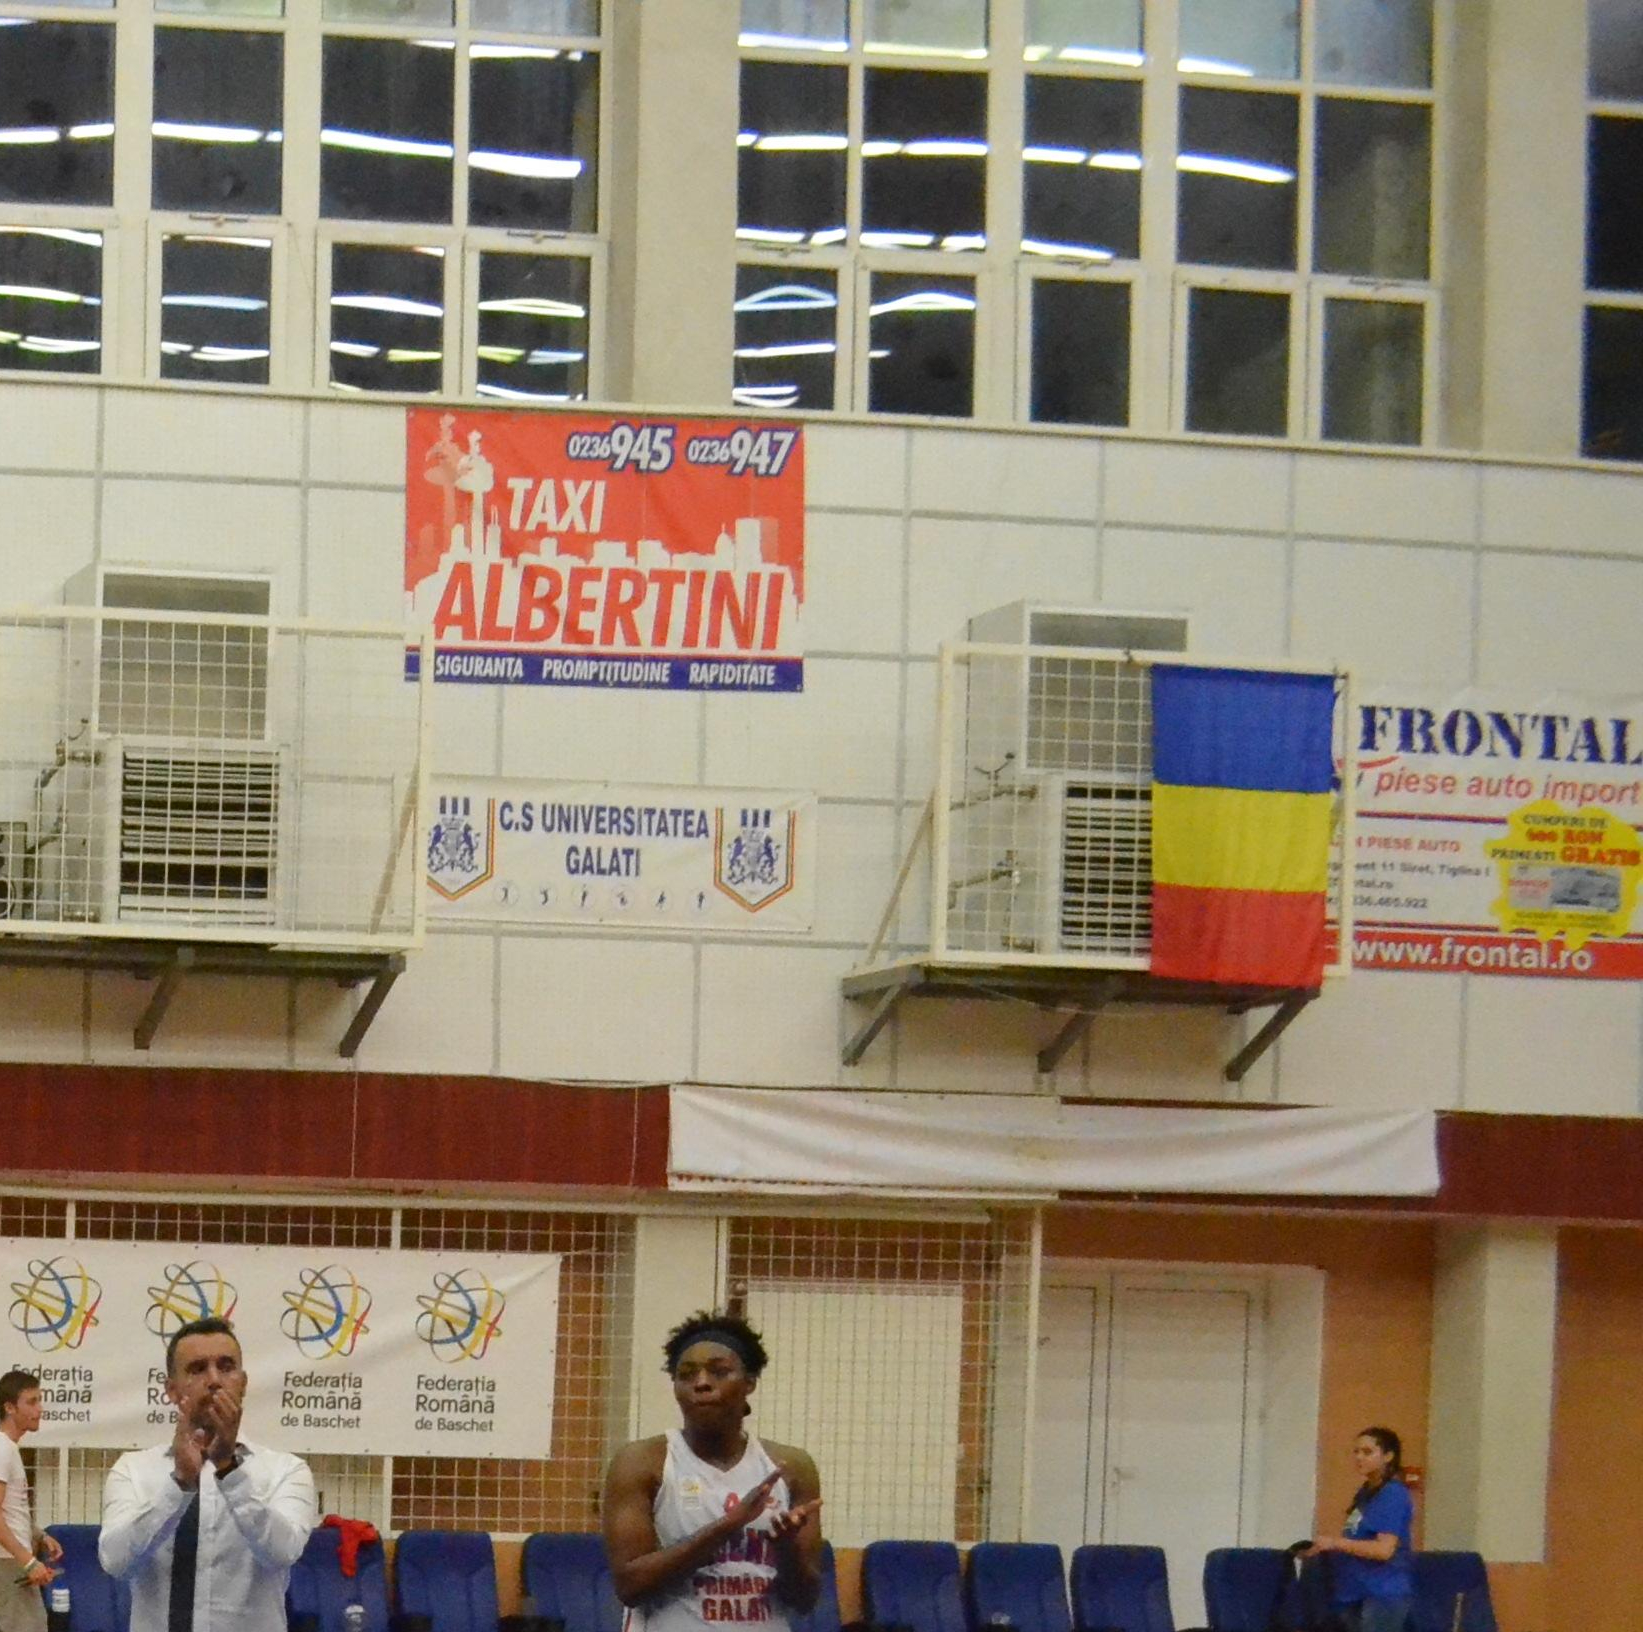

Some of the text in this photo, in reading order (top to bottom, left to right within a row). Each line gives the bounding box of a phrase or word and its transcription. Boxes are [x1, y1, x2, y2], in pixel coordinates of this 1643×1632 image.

[507, 477, 605, 534] TAXI
[433, 561, 786, 651] ALBERTINI
[542, 659, 672, 683] PROMPTITUDINE
[689, 662, 776, 686] RAPIDITATE
[1358, 704, 1643, 765] FRONTAL
[1374, 767, 1641, 806] piese auto import
[542, 805, 710, 839] UNIVERSITATEA
[566, 846, 641, 877] GALATI
[1353, 938, 1593, 971] www.frontal.ro
[281, 1390, 362, 1411] Română
[415, 1393, 495, 1415] Română
[280, 1413, 361, 1428] de Baschet
[415, 1416, 494, 1432] de Baschet
